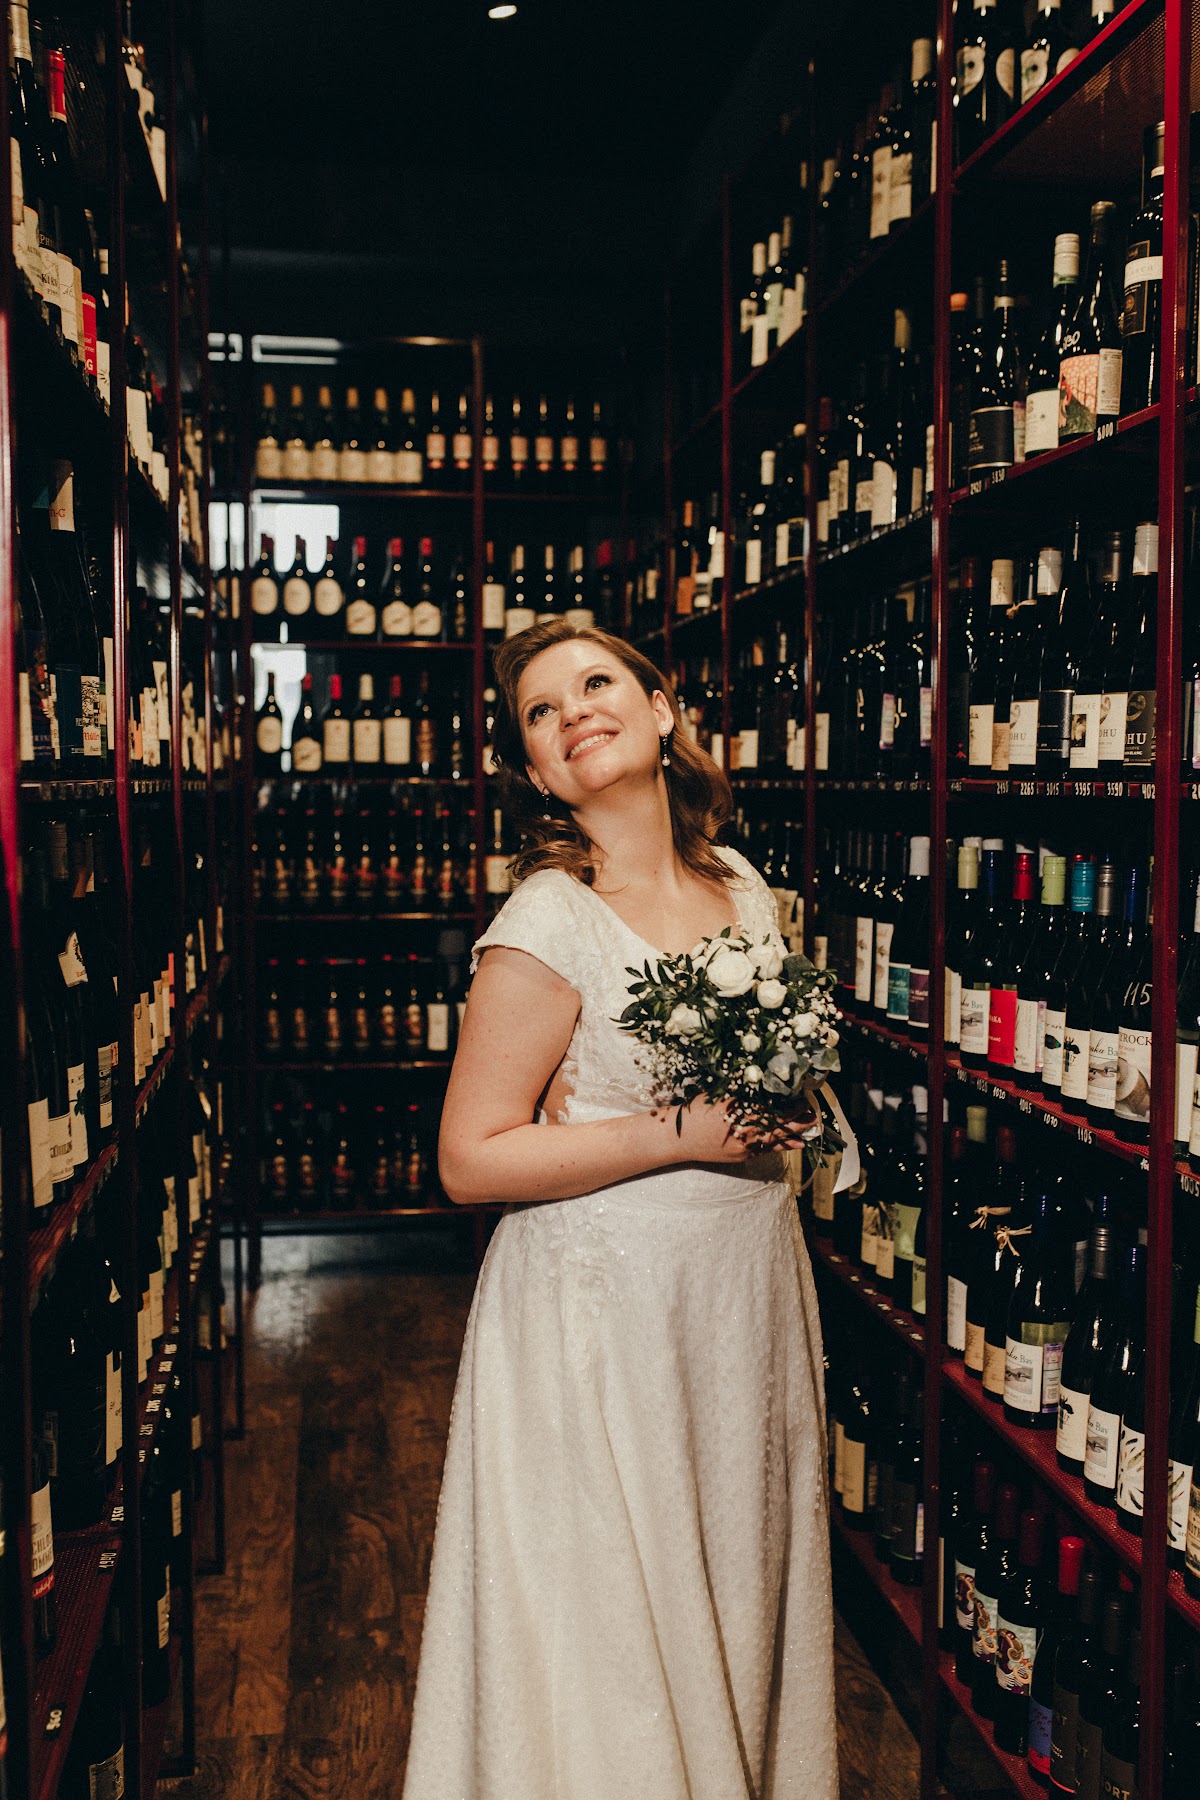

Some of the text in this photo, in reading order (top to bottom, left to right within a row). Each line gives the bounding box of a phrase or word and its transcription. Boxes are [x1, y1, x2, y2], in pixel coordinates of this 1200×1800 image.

[85, 358, 94, 371] G
[1125, 732, 1148, 745] HU
[1142, 783, 1156, 799] 402
[1107, 1046, 1119, 1057] Ba
[1077, 1126, 1093, 1145] 1105
